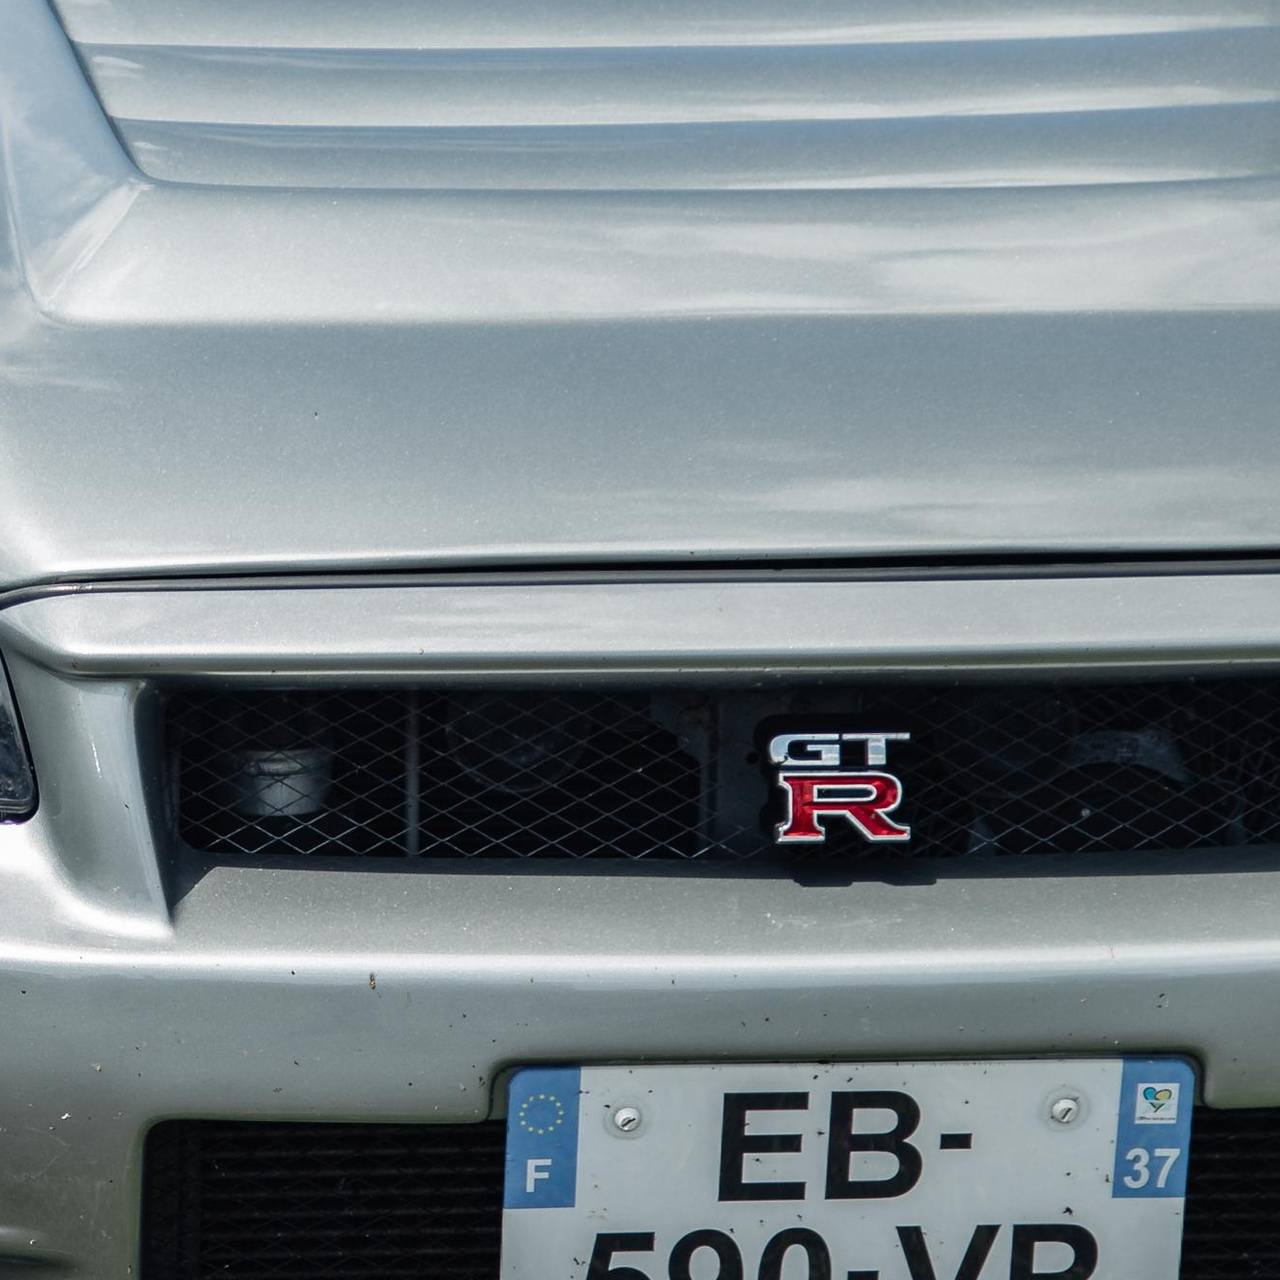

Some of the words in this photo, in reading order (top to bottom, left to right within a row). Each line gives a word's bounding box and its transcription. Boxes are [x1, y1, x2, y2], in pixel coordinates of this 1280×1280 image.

[770, 732, 910, 766] GT
[776, 771, 911, 842] R
[718, 1090, 973, 1202] EB-
[525, 1158, 552, 1193] F
[1123, 1147, 1181, 1189] 37
